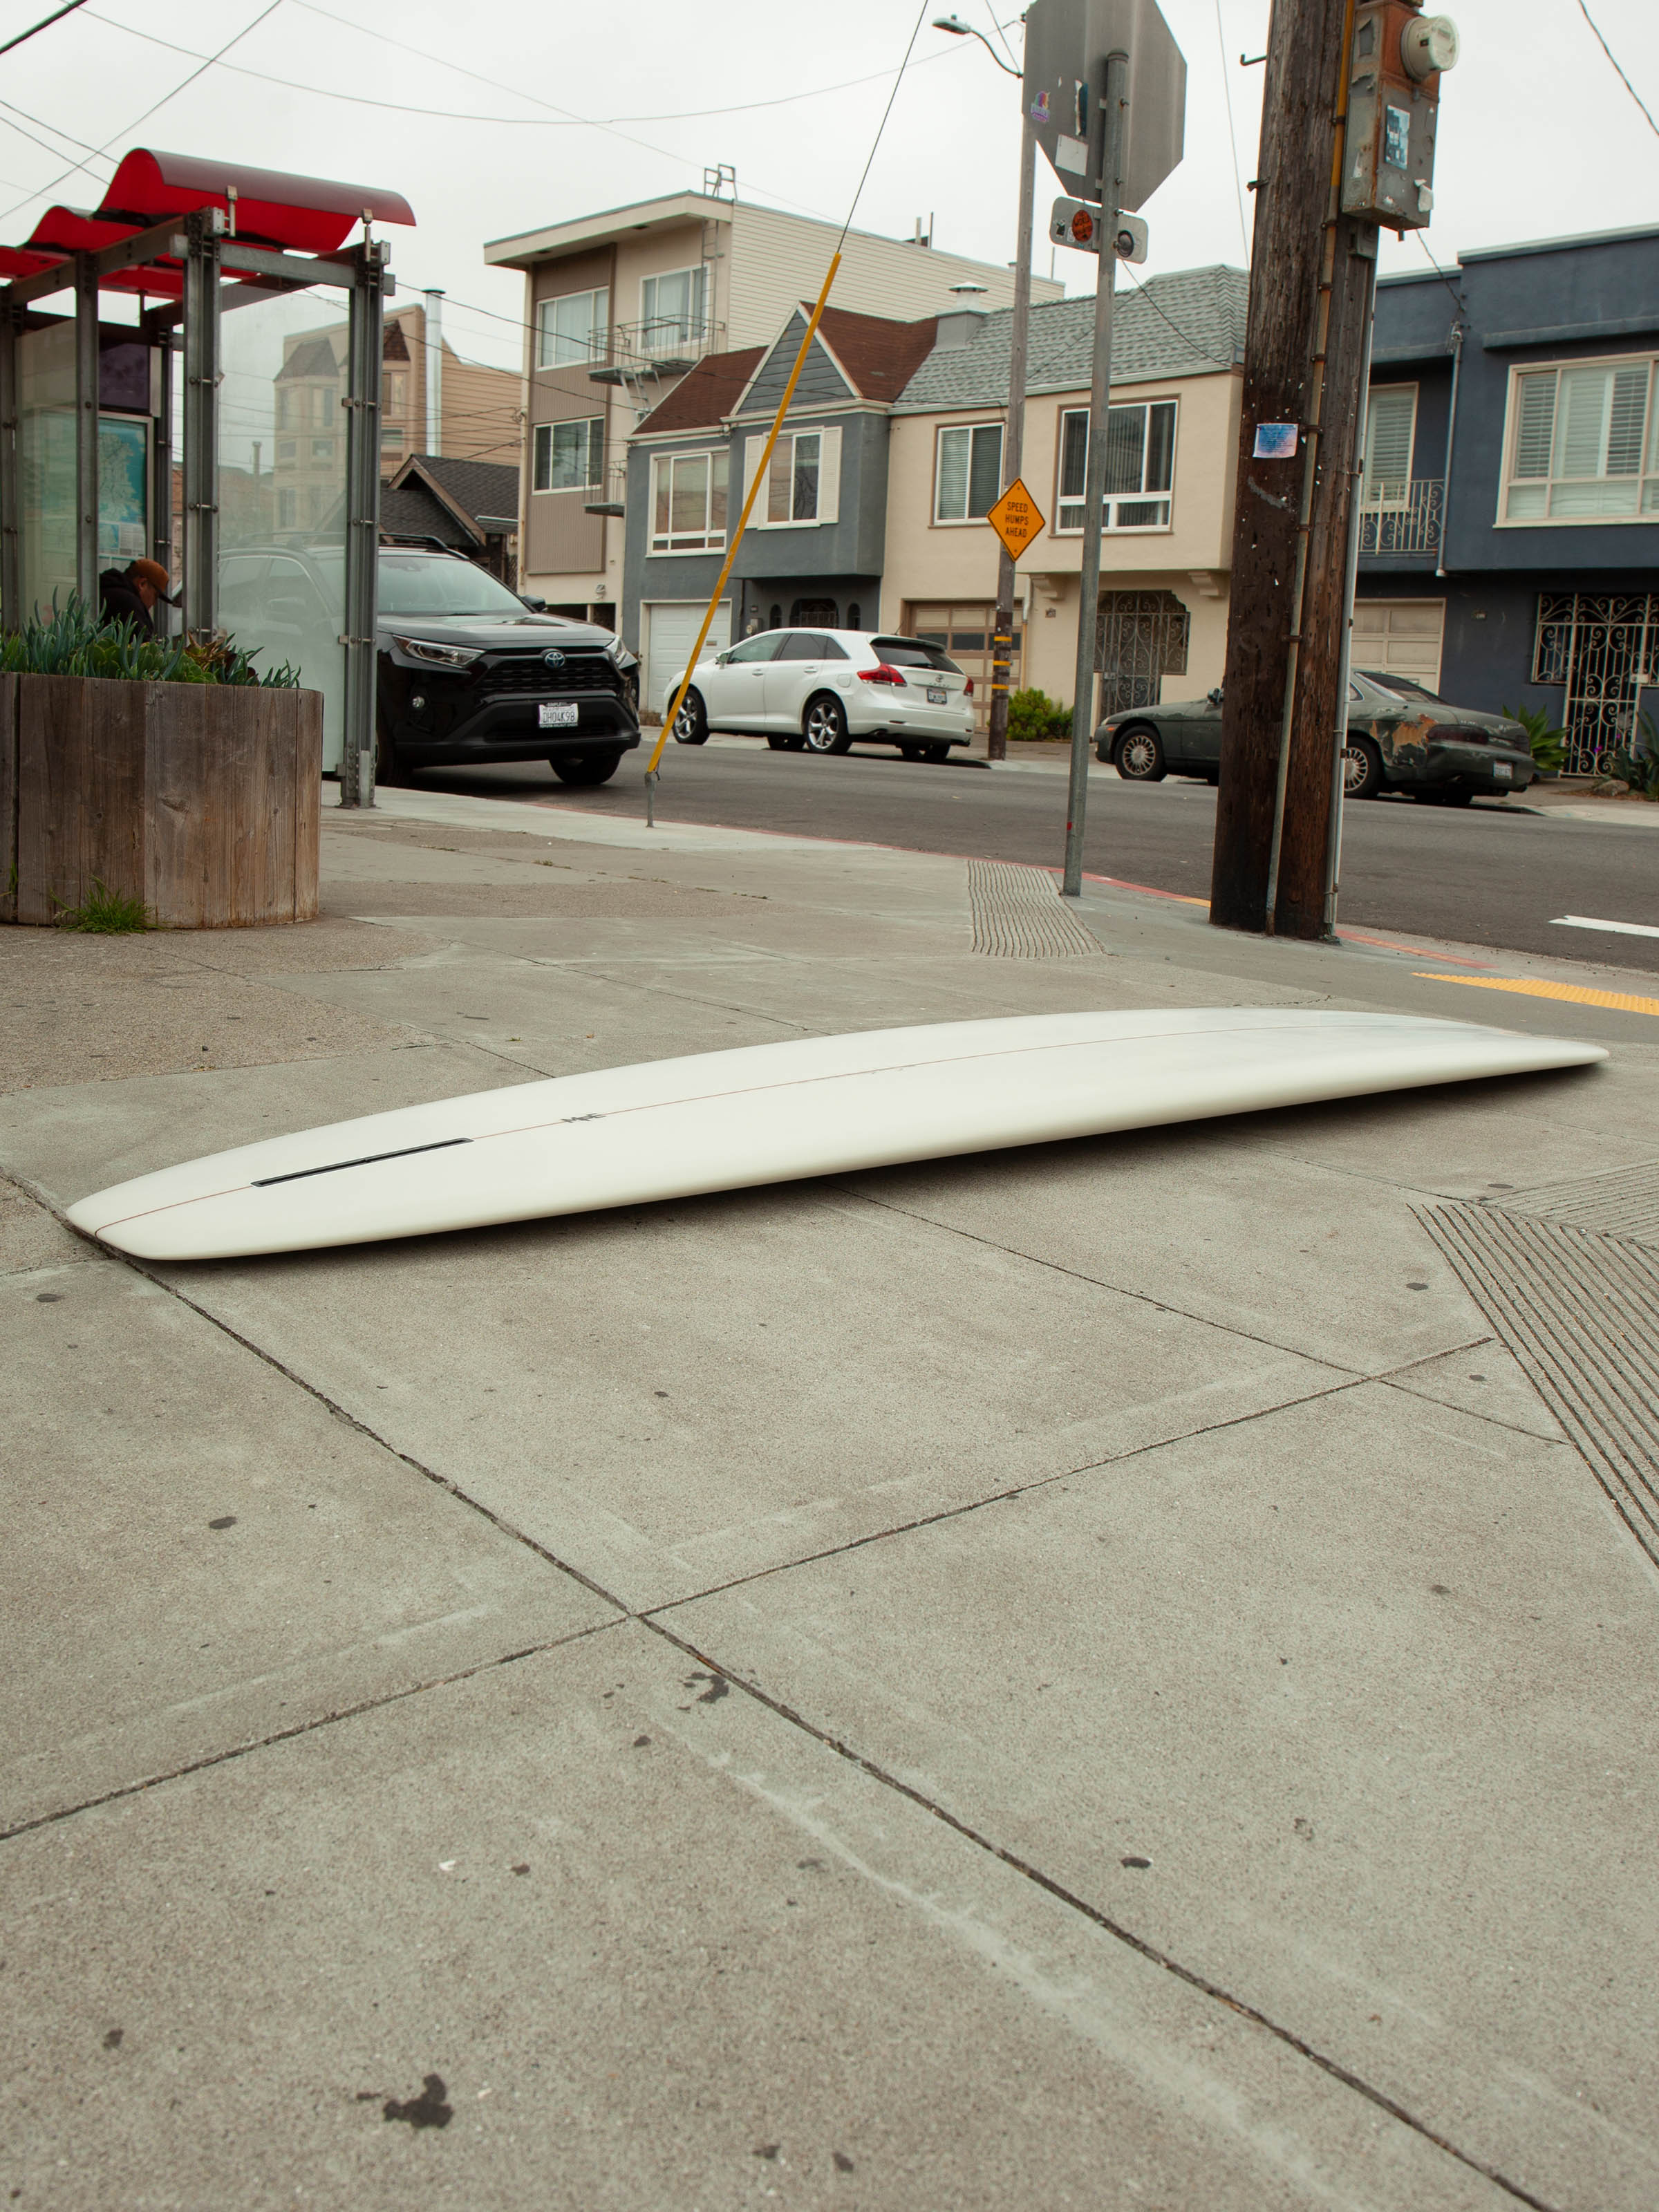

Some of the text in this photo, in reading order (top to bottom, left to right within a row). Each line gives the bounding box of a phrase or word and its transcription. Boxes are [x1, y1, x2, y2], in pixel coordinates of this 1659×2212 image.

[1007, 501, 1028, 513] SPEED
[1005, 514, 1029, 525] HUMPS
[1005, 527, 1027, 538] AHEAD
[543, 711, 575, 724] DH04K98
